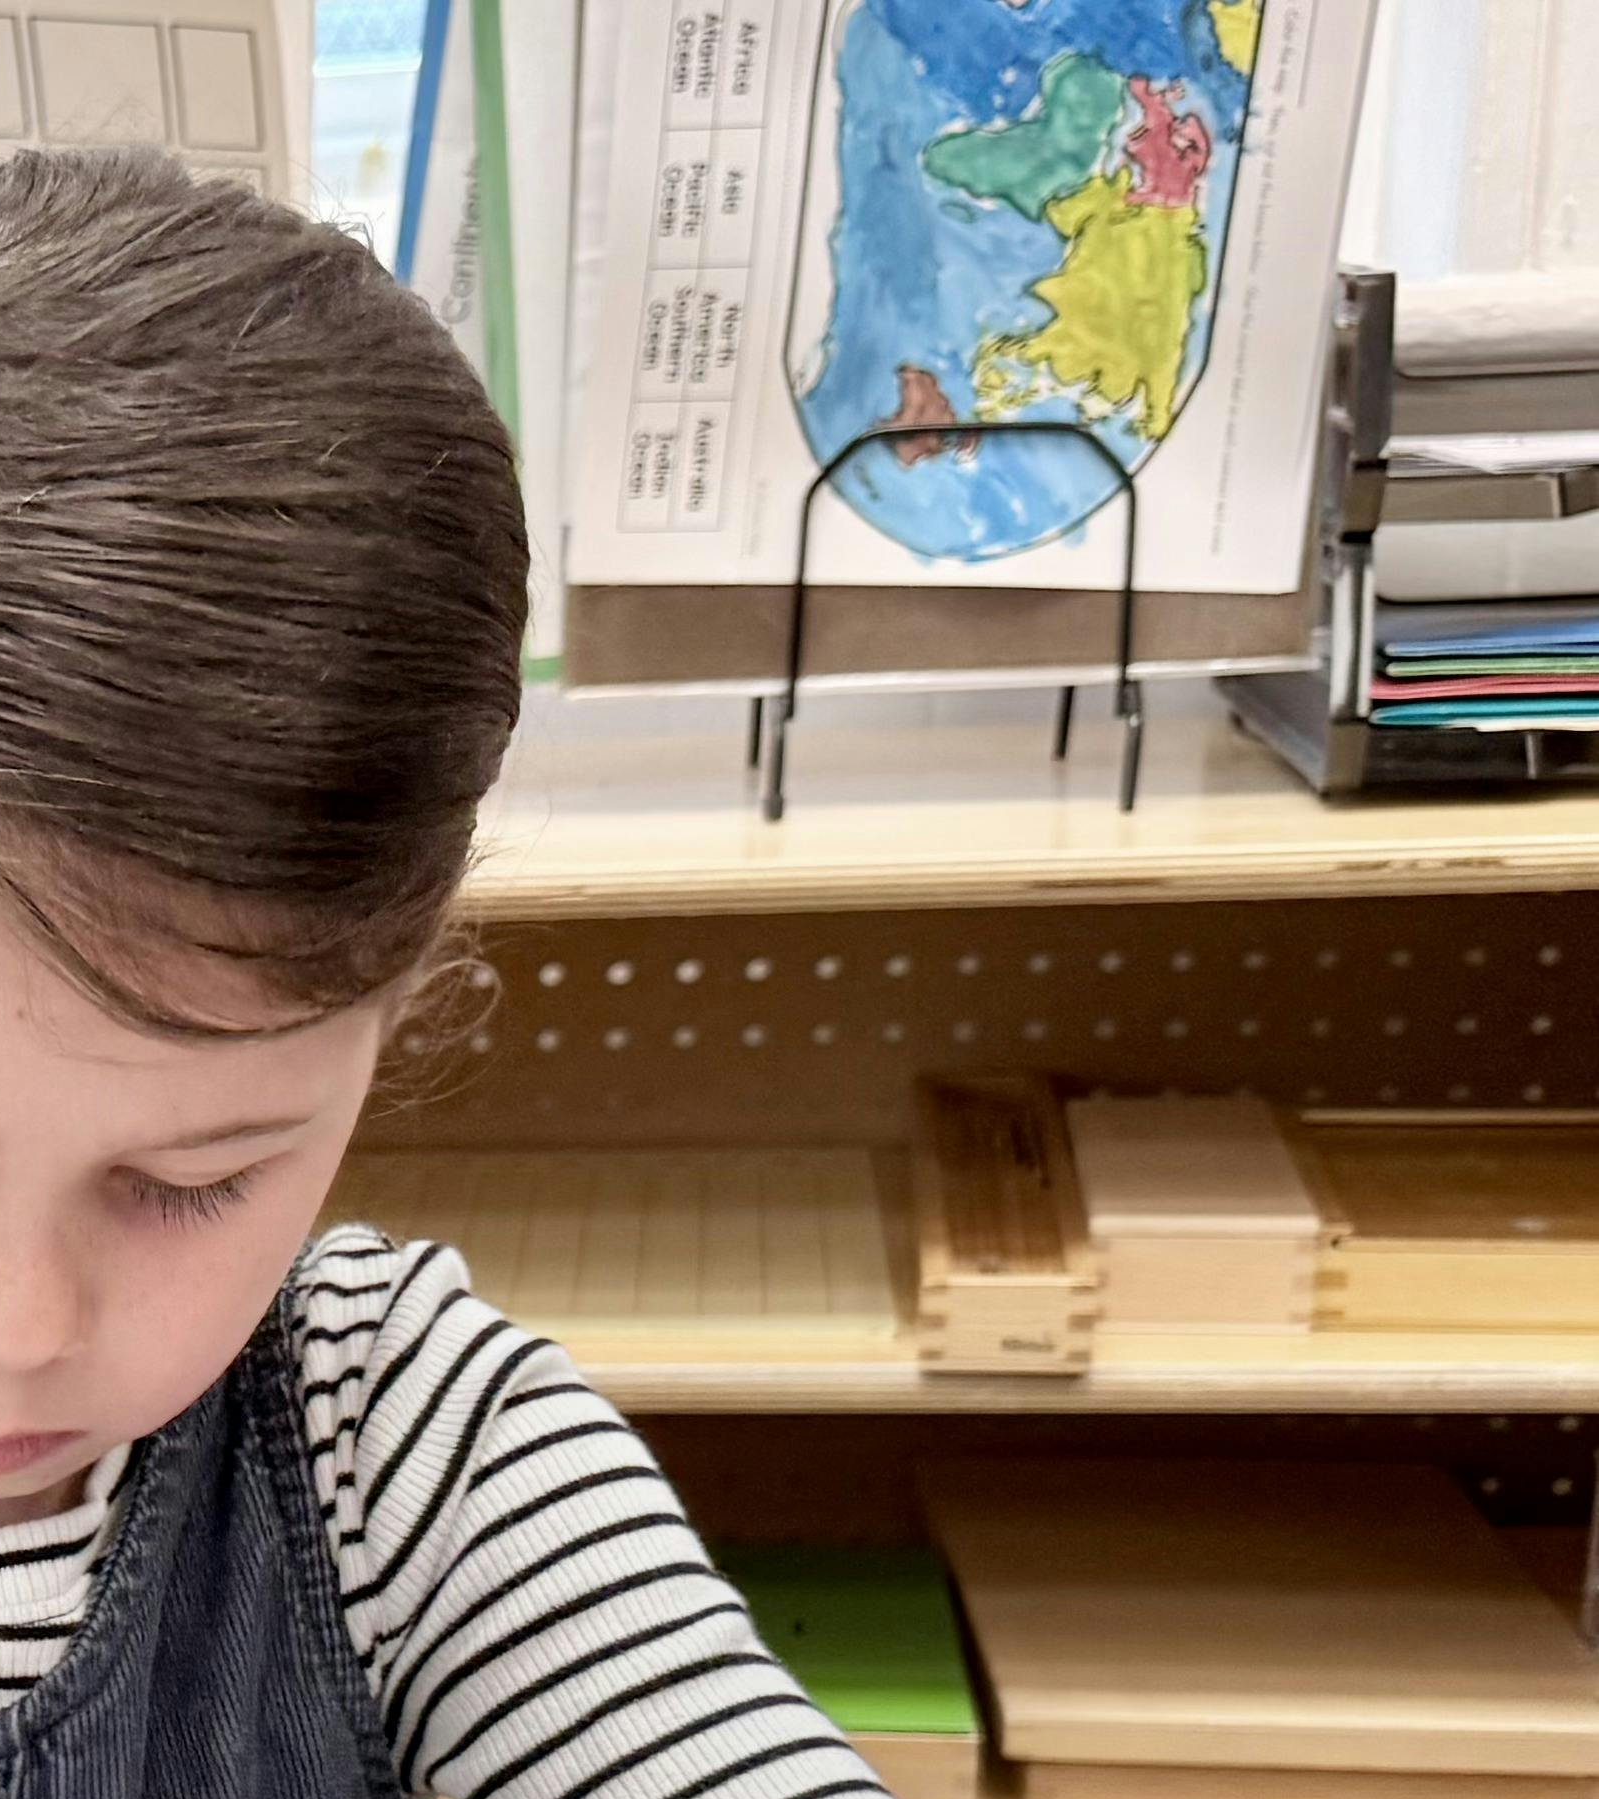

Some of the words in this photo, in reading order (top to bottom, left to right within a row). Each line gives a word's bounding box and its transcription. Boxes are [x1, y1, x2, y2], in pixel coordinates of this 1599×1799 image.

[671, 17, 697, 94] Ocean
[694, 13, 721, 100] Atlantic
[657, 165, 684, 238] Ocean
[681, 162, 708, 238] Pacific
[721, 168, 745, 215] Asia
[641, 301, 669, 371] Ocean
[628, 429, 651, 500] Ocean
